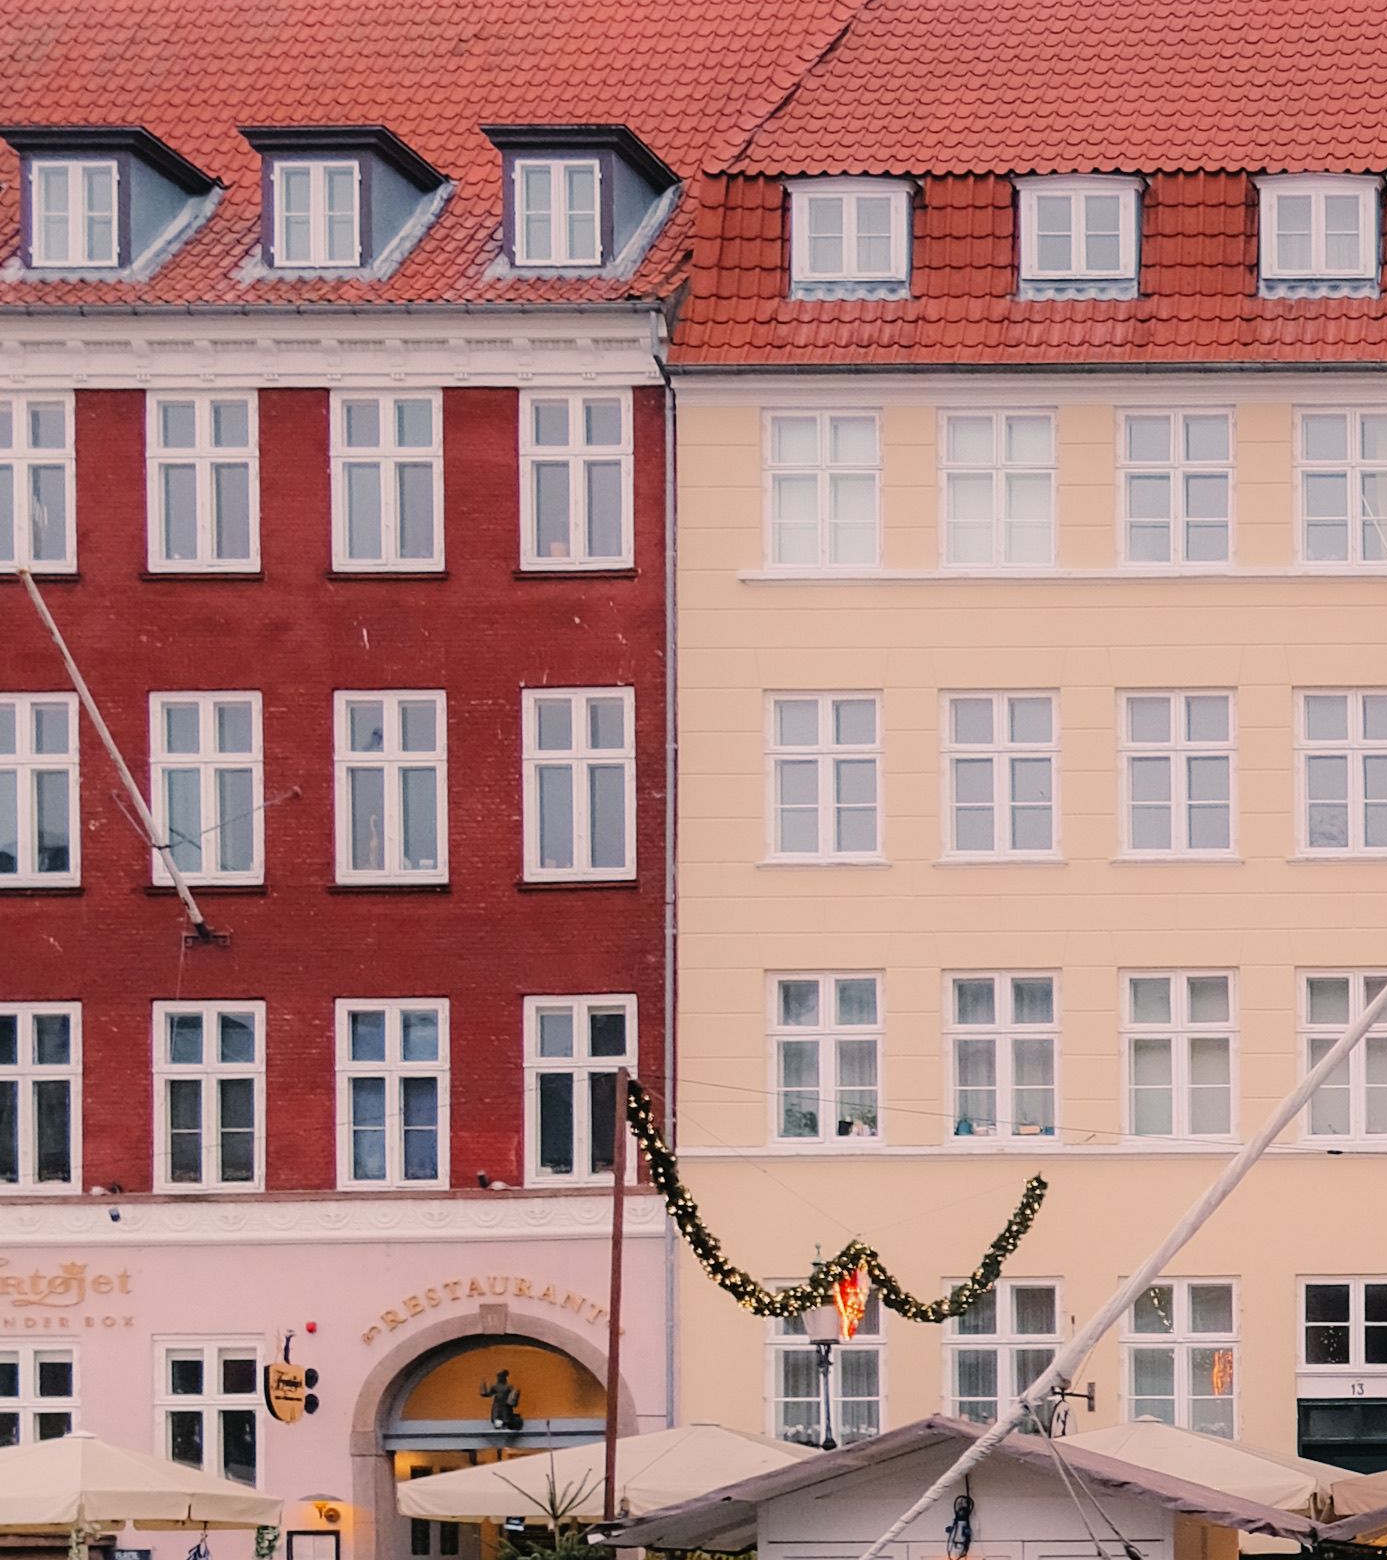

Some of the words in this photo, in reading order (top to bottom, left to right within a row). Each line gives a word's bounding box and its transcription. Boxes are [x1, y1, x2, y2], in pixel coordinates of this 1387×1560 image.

[380, 1276, 609, 1332] RESTAURANT
[84, 1315, 134, 1328] BOX
[1351, 1383, 1365, 1395] 13
